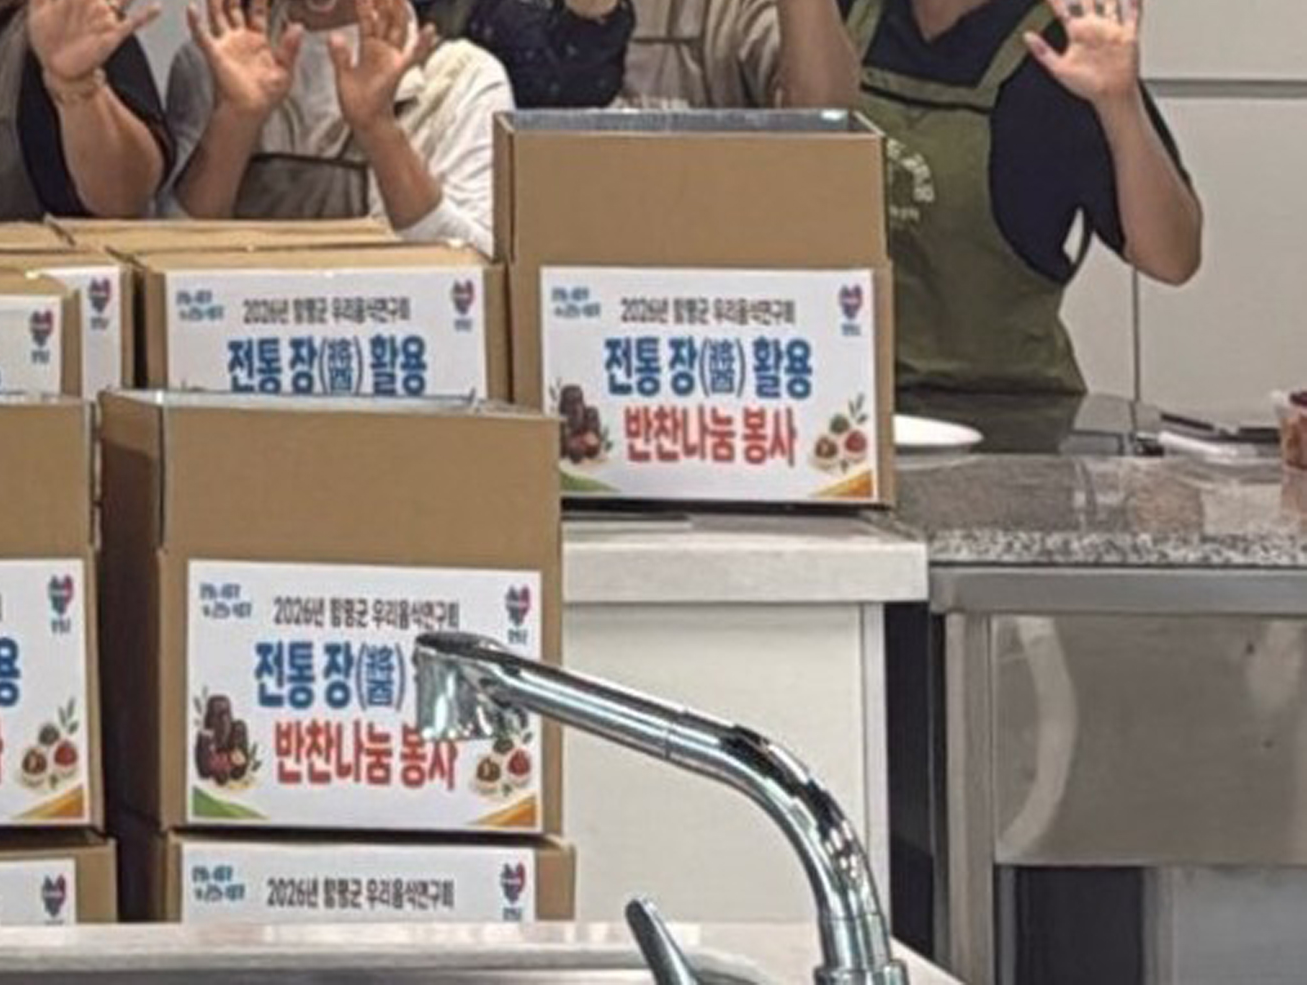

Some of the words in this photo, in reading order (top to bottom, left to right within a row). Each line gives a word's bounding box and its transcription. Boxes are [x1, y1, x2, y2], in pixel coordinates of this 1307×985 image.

[228, 338, 281, 394] 전통
[369, 334, 427, 396] 활용
[605, 337, 661, 396] 전통
[753, 336, 812, 400] 활용
[624, 404, 735, 464] 반찬나눔
[743, 407, 797, 466] 봉사
[255, 640, 315, 710] 전통
[275, 720, 393, 786] 반찬나눔
